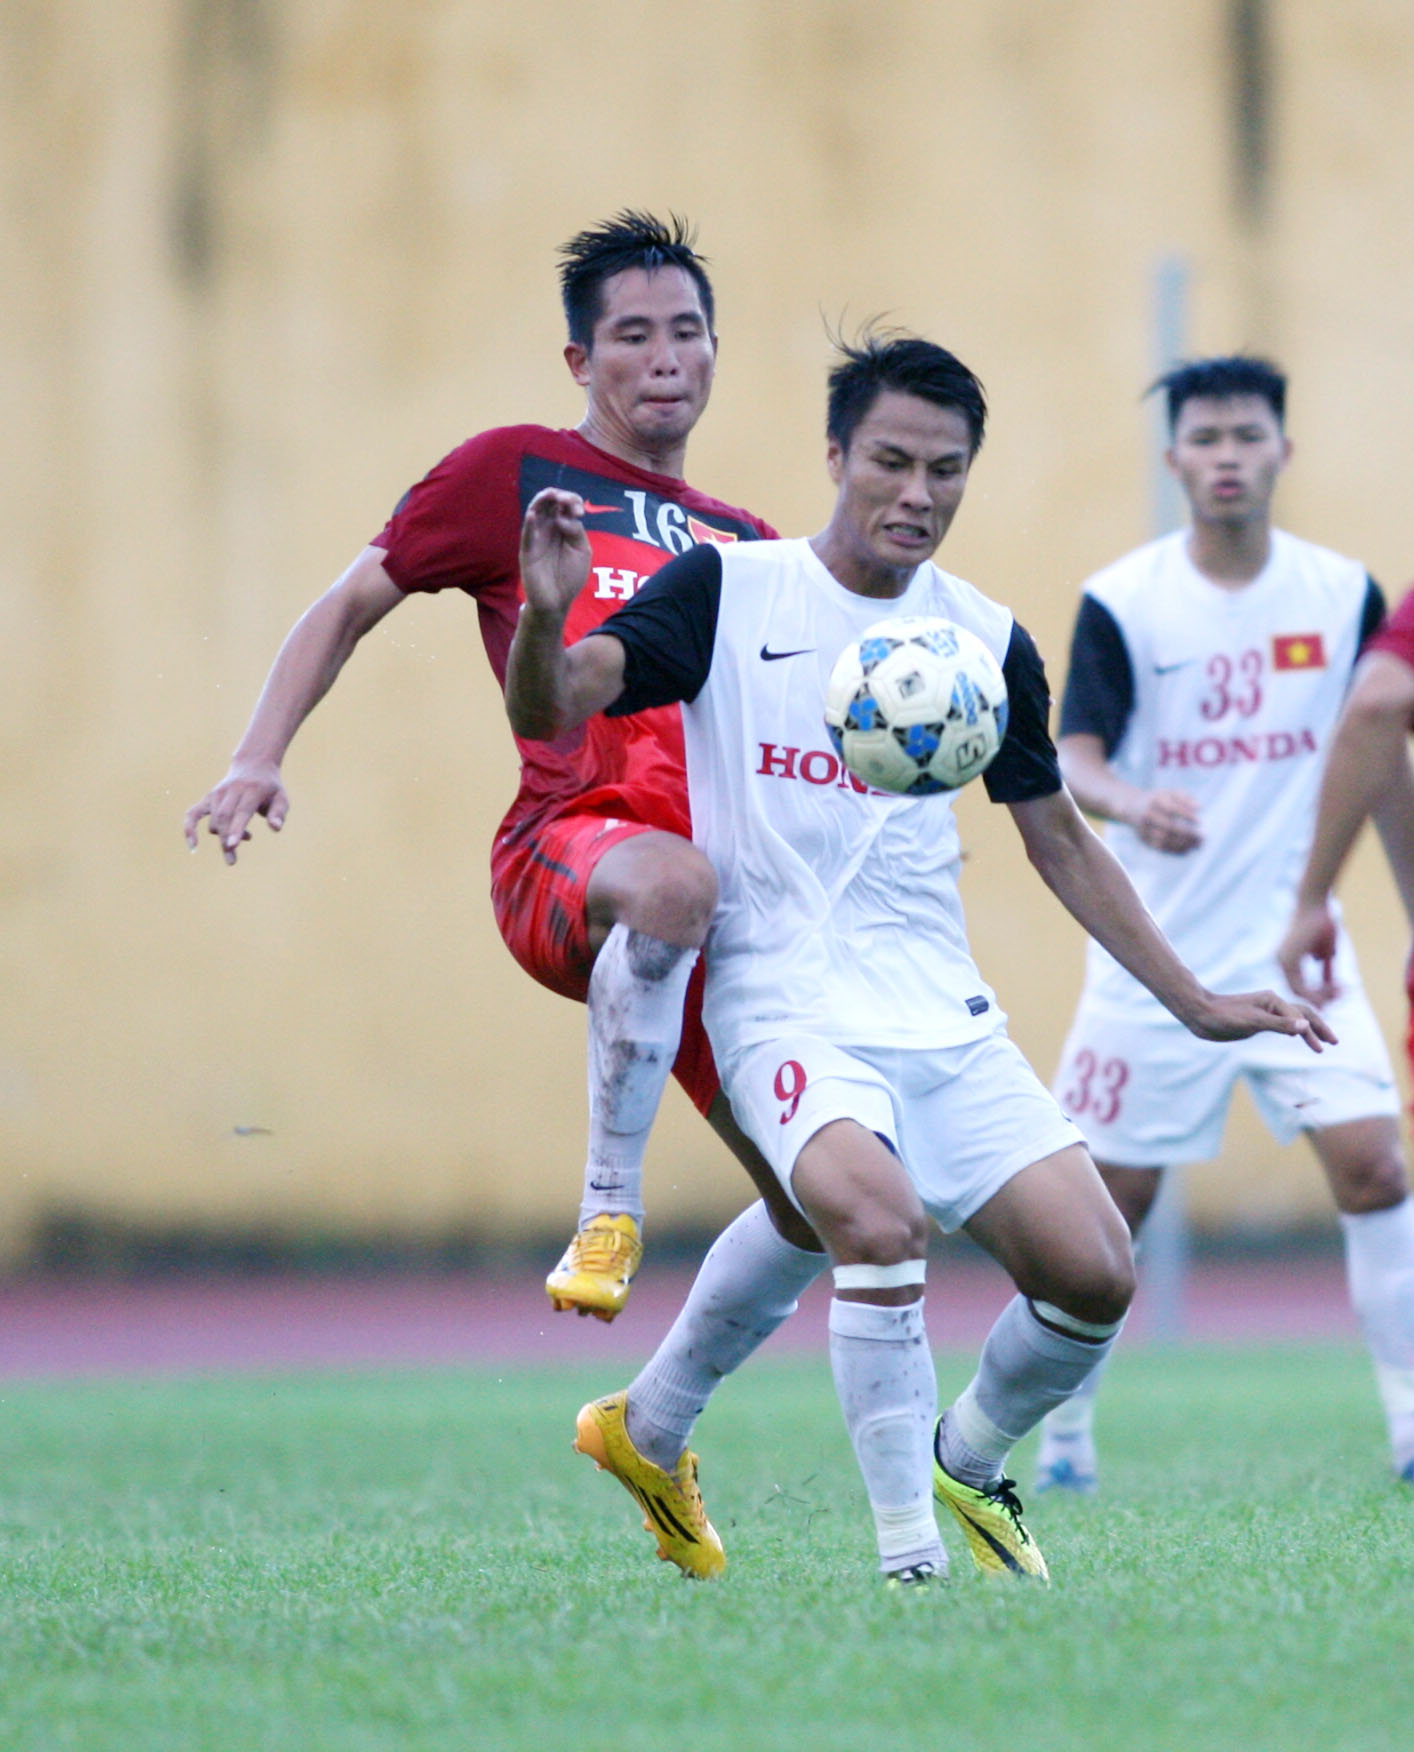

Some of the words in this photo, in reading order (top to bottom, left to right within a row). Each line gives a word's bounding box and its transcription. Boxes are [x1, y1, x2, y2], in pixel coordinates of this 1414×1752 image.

[624, 490, 694, 556] 16
[1201, 650, 1263, 721] 33
[756, 742, 893, 797] HON
[1157, 729, 1317, 768] HONDA
[774, 1060, 807, 1125] 9
[1064, 1049, 1129, 1125] 33
